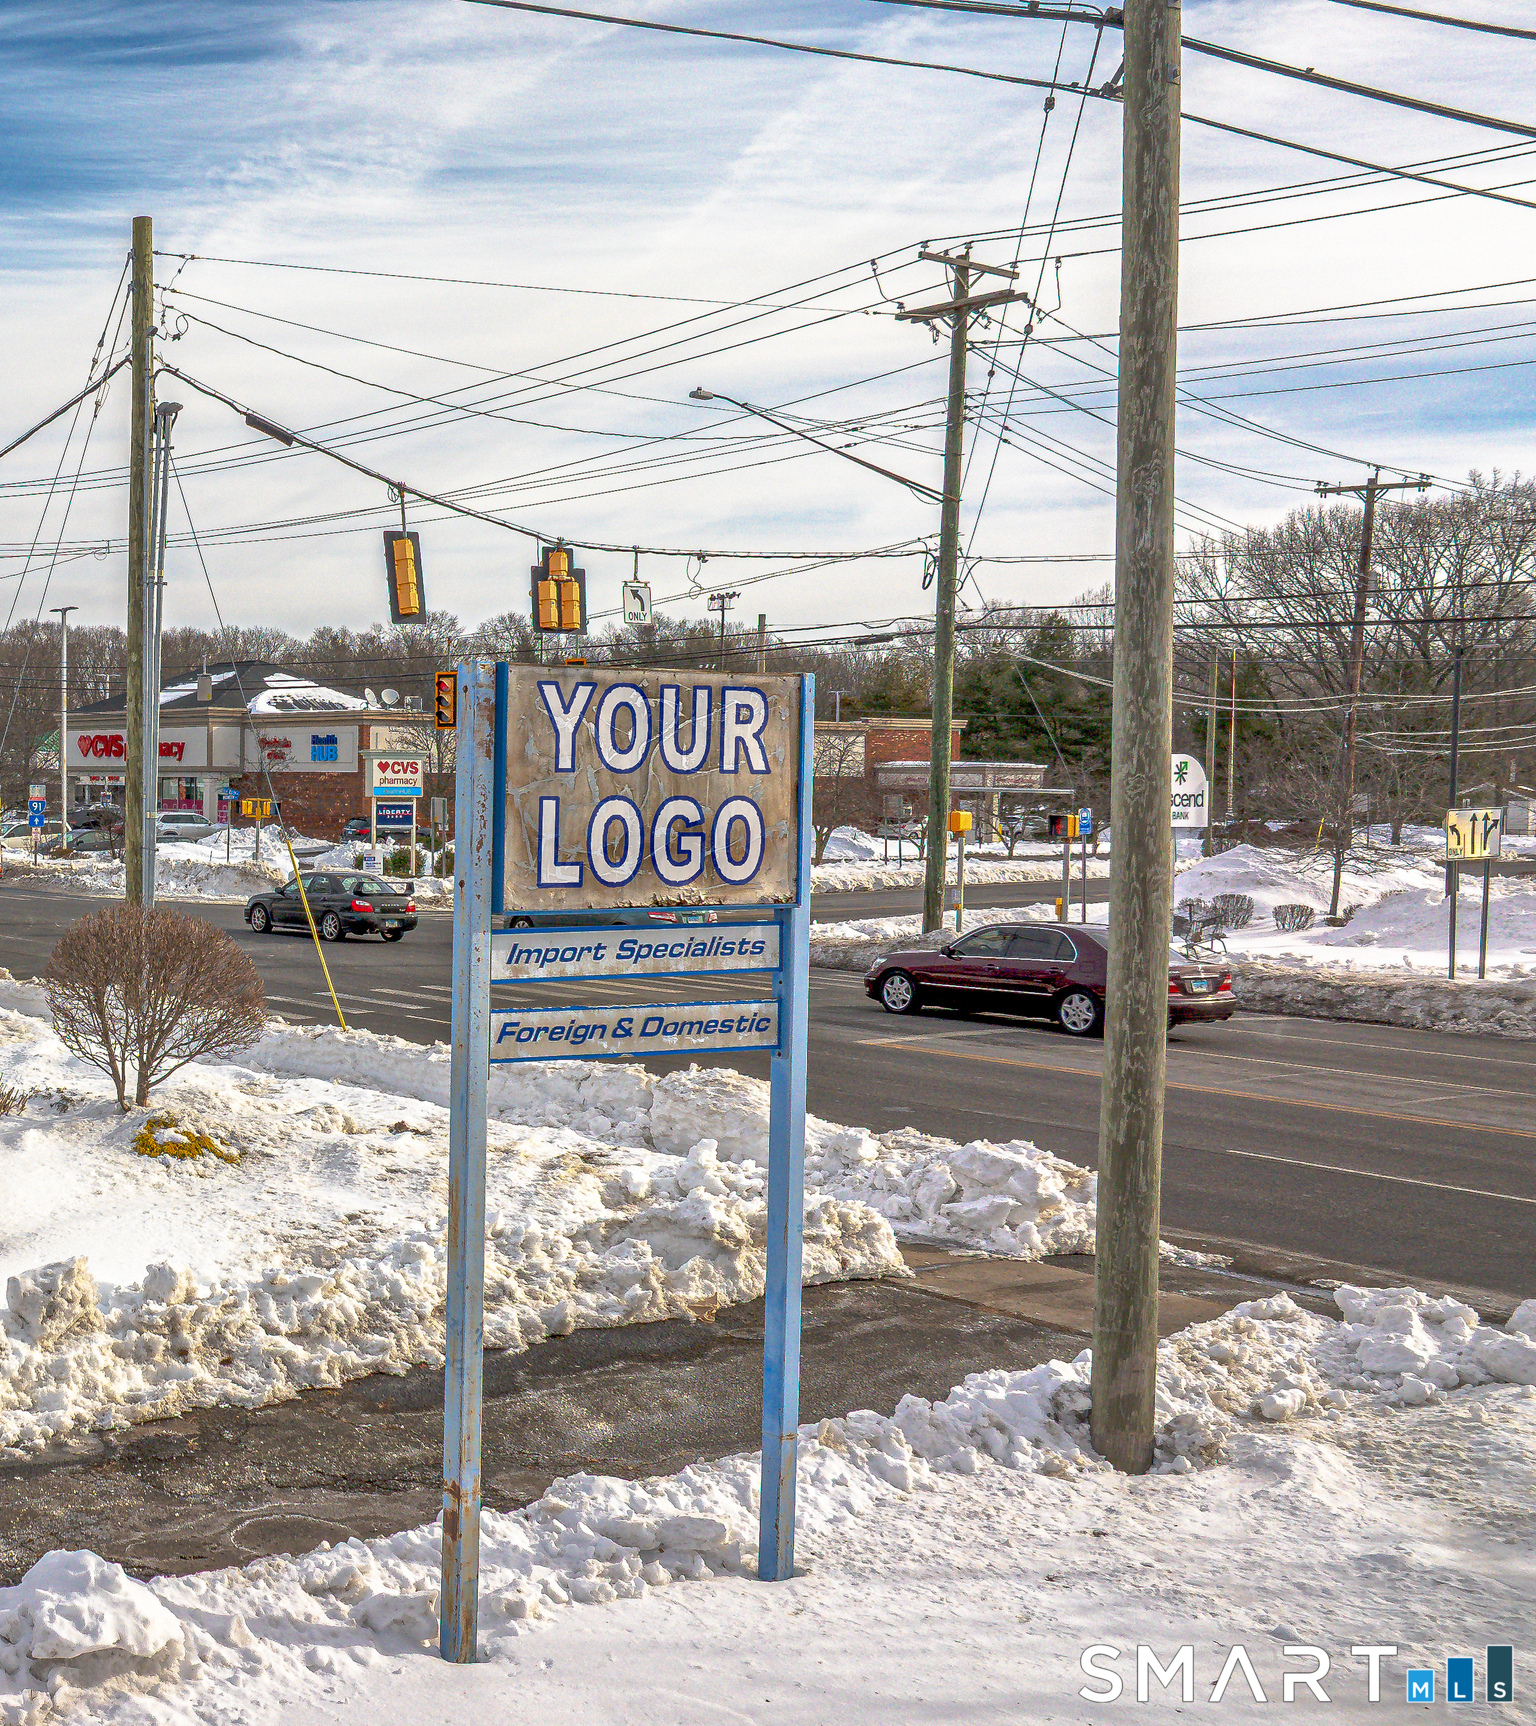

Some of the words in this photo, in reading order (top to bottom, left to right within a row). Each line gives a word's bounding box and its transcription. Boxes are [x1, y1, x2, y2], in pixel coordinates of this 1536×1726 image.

[628, 611, 647, 622] ONLY
[537, 681, 771, 774] YOUR
[92, 734, 124, 758] CVS
[311, 746, 338, 761] HUB
[391, 761, 418, 774] CVS
[379, 776, 417, 786] pharmacy
[1171, 790, 1204, 807] cend
[32, 802, 42, 811] 91
[378, 807, 411, 815] LIBERTY
[1172, 811, 1189, 821] BANK
[536, 795, 765, 888] LOGO
[505, 942, 607, 968] Import
[615, 936, 766, 964] Specialists
[496, 1019, 607, 1046] Foreign
[611, 1017, 633, 1039] &
[639, 1012, 772, 1038] Domestic
